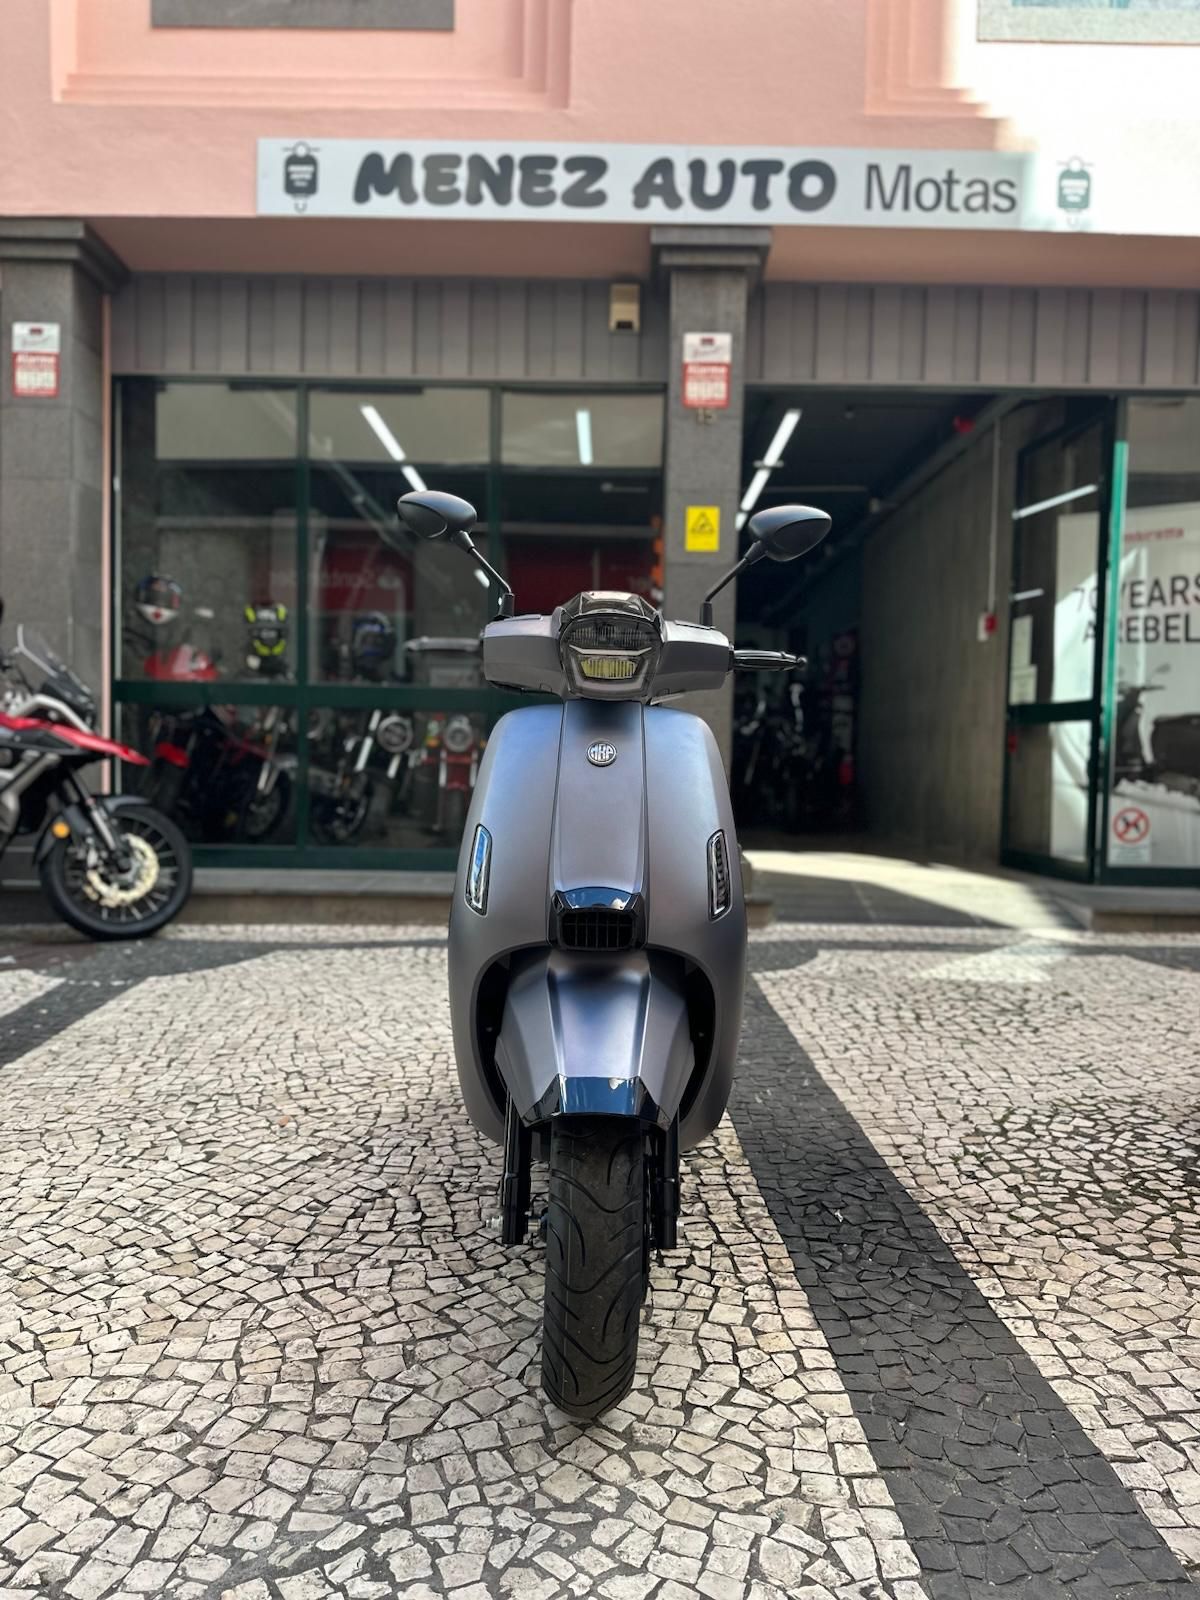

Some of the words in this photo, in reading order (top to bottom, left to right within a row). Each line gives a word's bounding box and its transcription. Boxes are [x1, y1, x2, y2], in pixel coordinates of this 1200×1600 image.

[353, 152, 609, 209] MENEZ
[632, 157, 837, 212] AUTO
[865, 163, 1018, 213] Motas
[1118, 613, 1200, 643] EBEL
